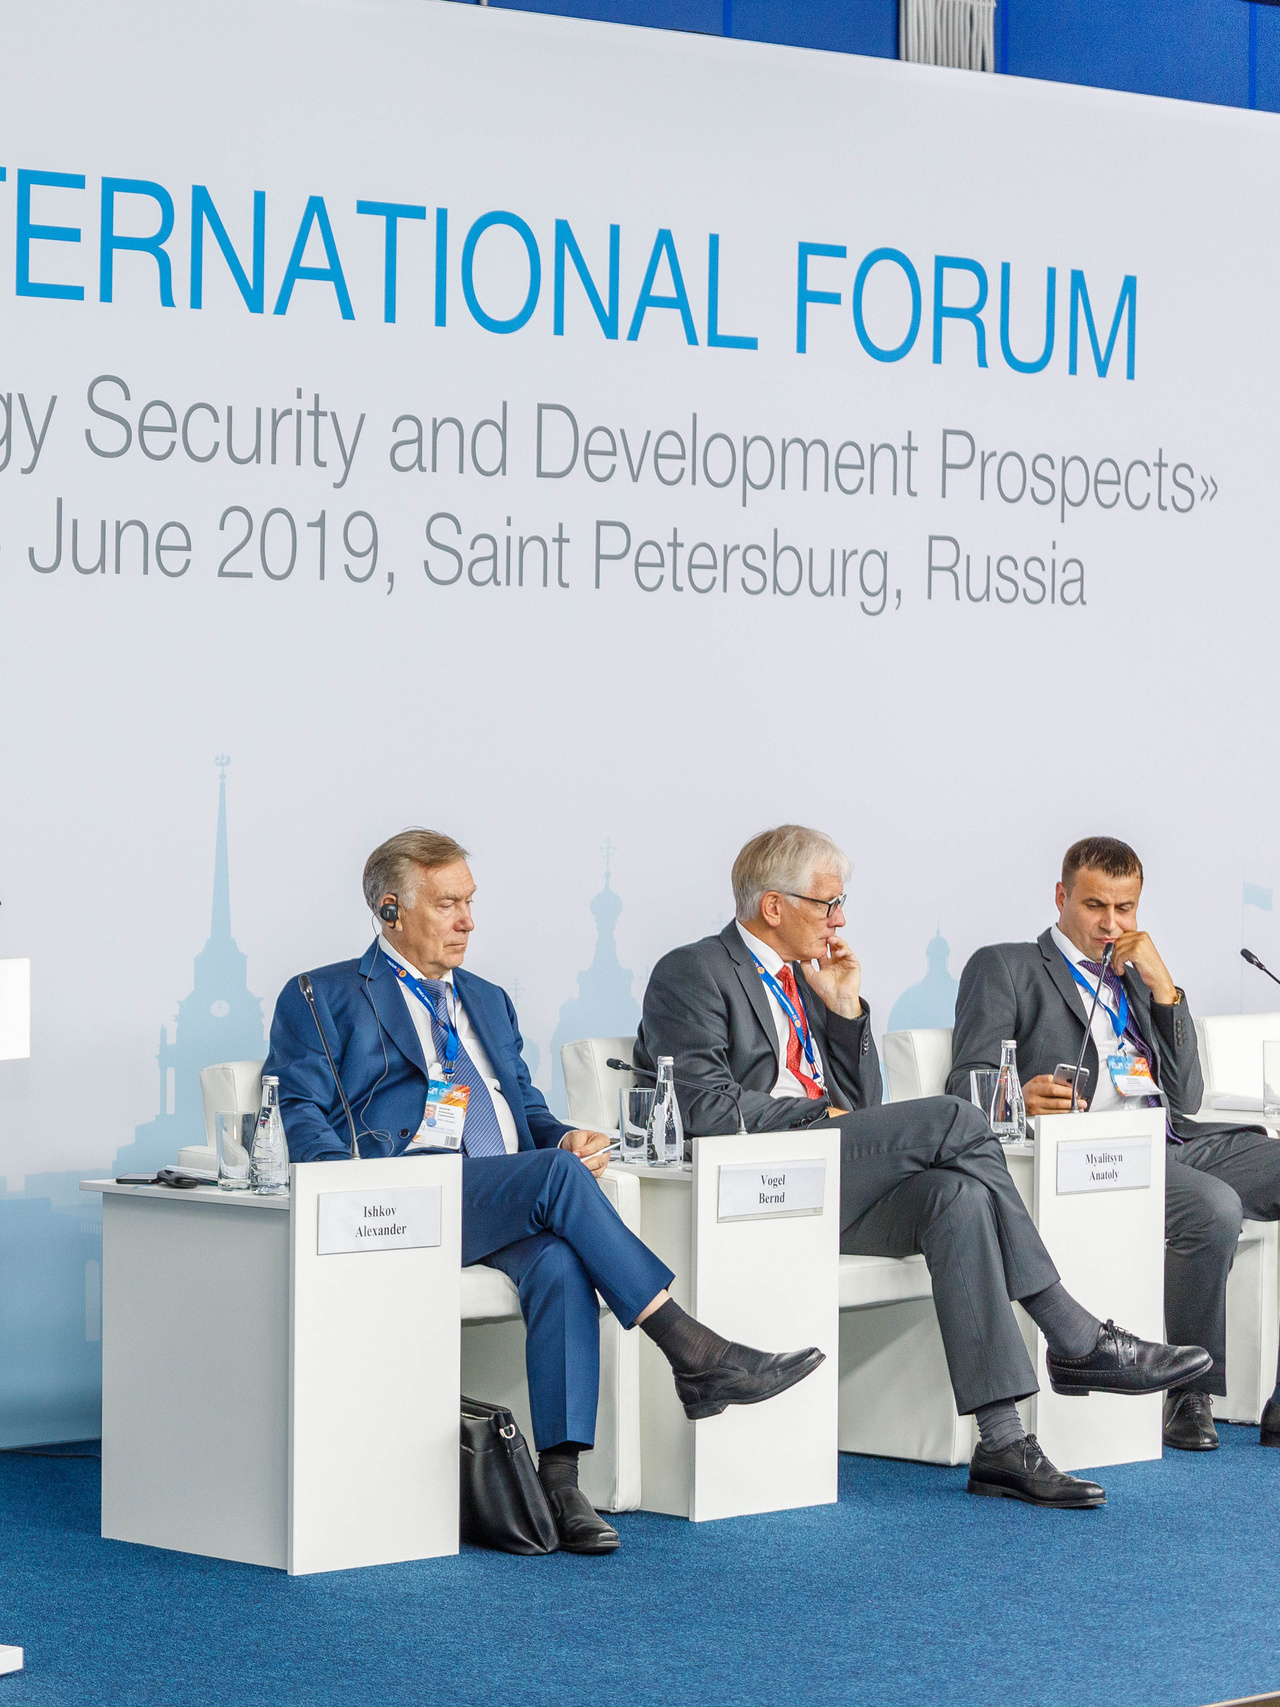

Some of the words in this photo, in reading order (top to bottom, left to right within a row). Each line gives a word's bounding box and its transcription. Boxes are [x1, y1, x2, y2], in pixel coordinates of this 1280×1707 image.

[795, 240, 1138, 381] FORUM
[84, 374, 366, 489] Security
[389, 400, 508, 477] and
[535, 402, 919, 508] Development
[941, 428, 1218, 524] Prospects»
[28, 496, 192, 578] June
[217, 505, 395, 596] 2019,
[423, 511, 571, 589] Saint
[594, 519, 902, 617] Petersburg,
[927, 534, 1087, 606] Russia
[1085, 1152, 1123, 1167] Myalitsyn
[760, 1174, 786, 1188] Vogel
[1089, 1168, 1120, 1182] Anatoly
[758, 1192, 785, 1204] Bernd
[363, 1205, 397, 1218] Ishkov
[355, 1223, 407, 1238] Alexander
